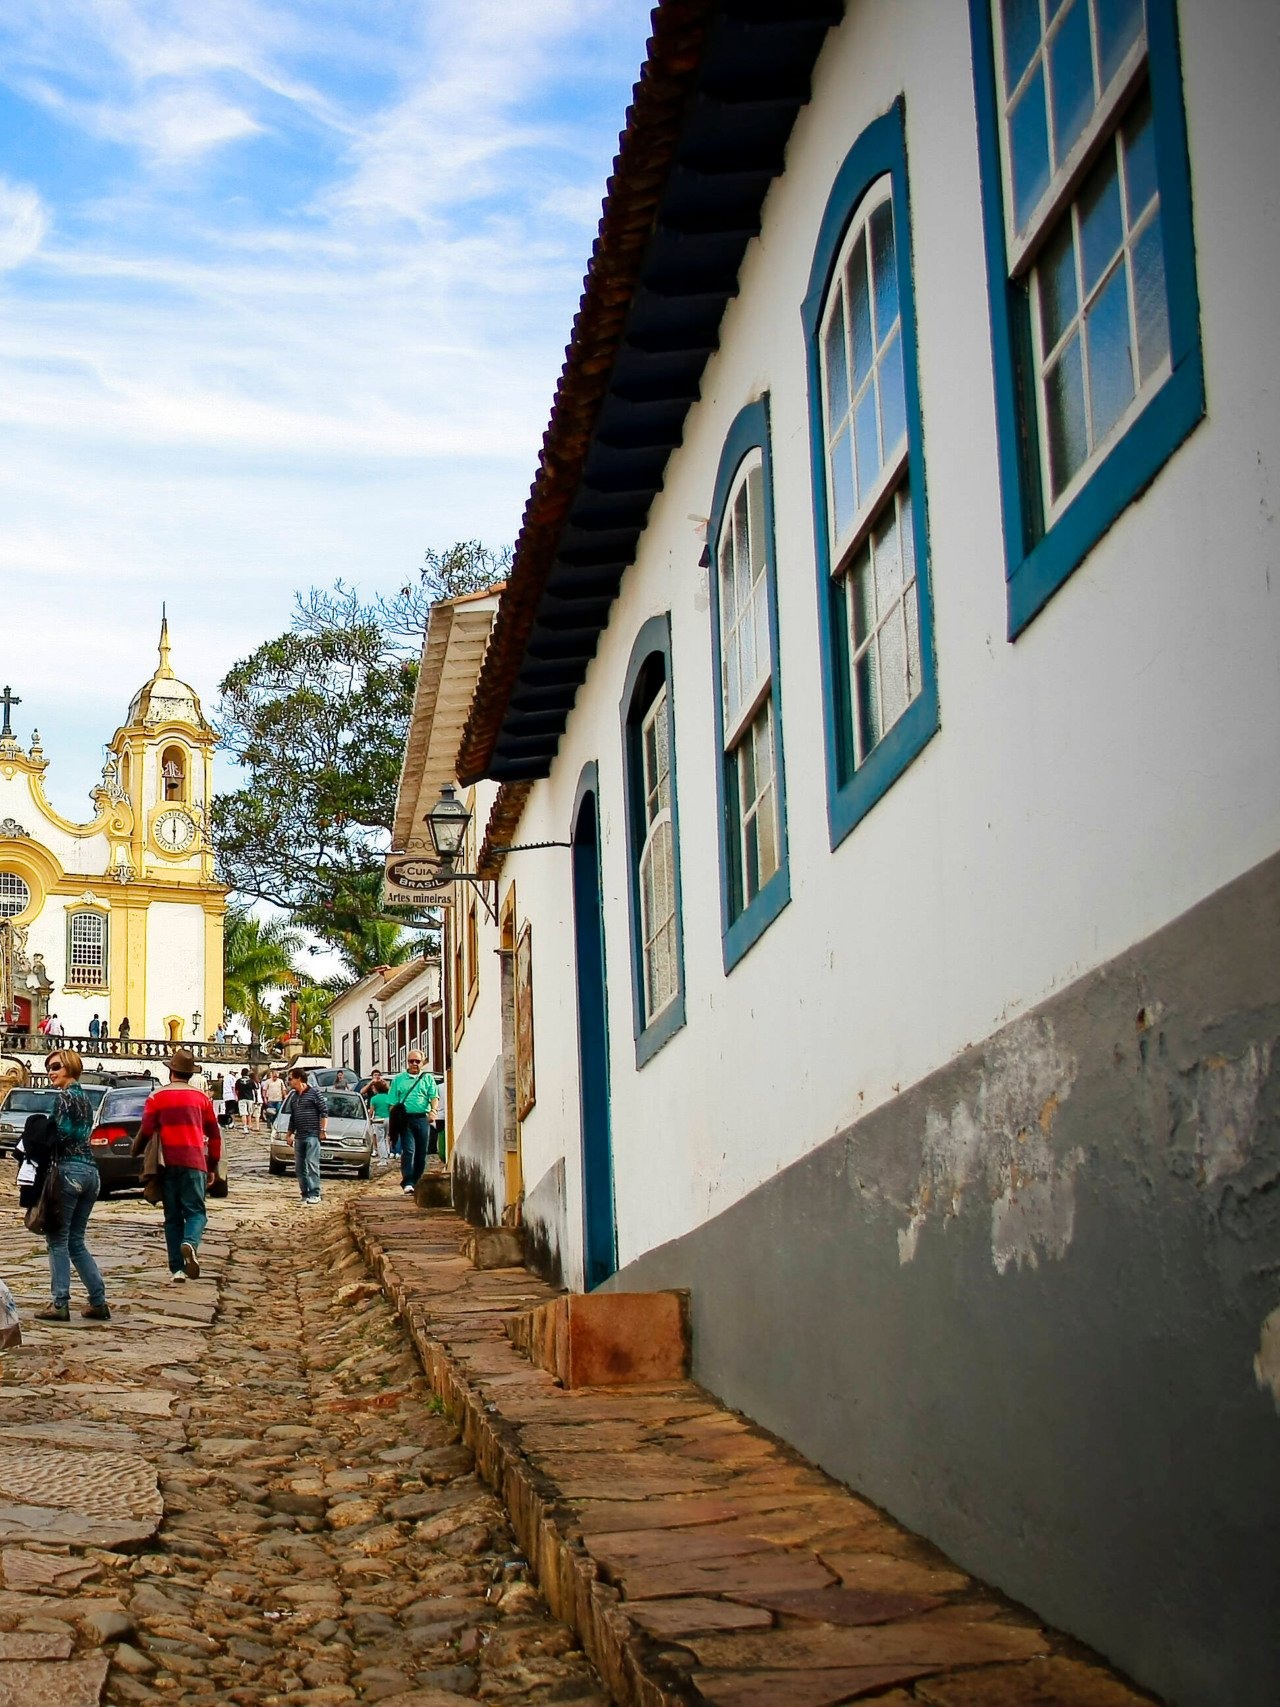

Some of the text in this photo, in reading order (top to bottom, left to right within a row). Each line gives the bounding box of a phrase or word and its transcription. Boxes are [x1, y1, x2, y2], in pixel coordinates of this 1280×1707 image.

[399, 877, 445, 889] BRASIL
[388, 892, 452, 904] Artes mineiras
